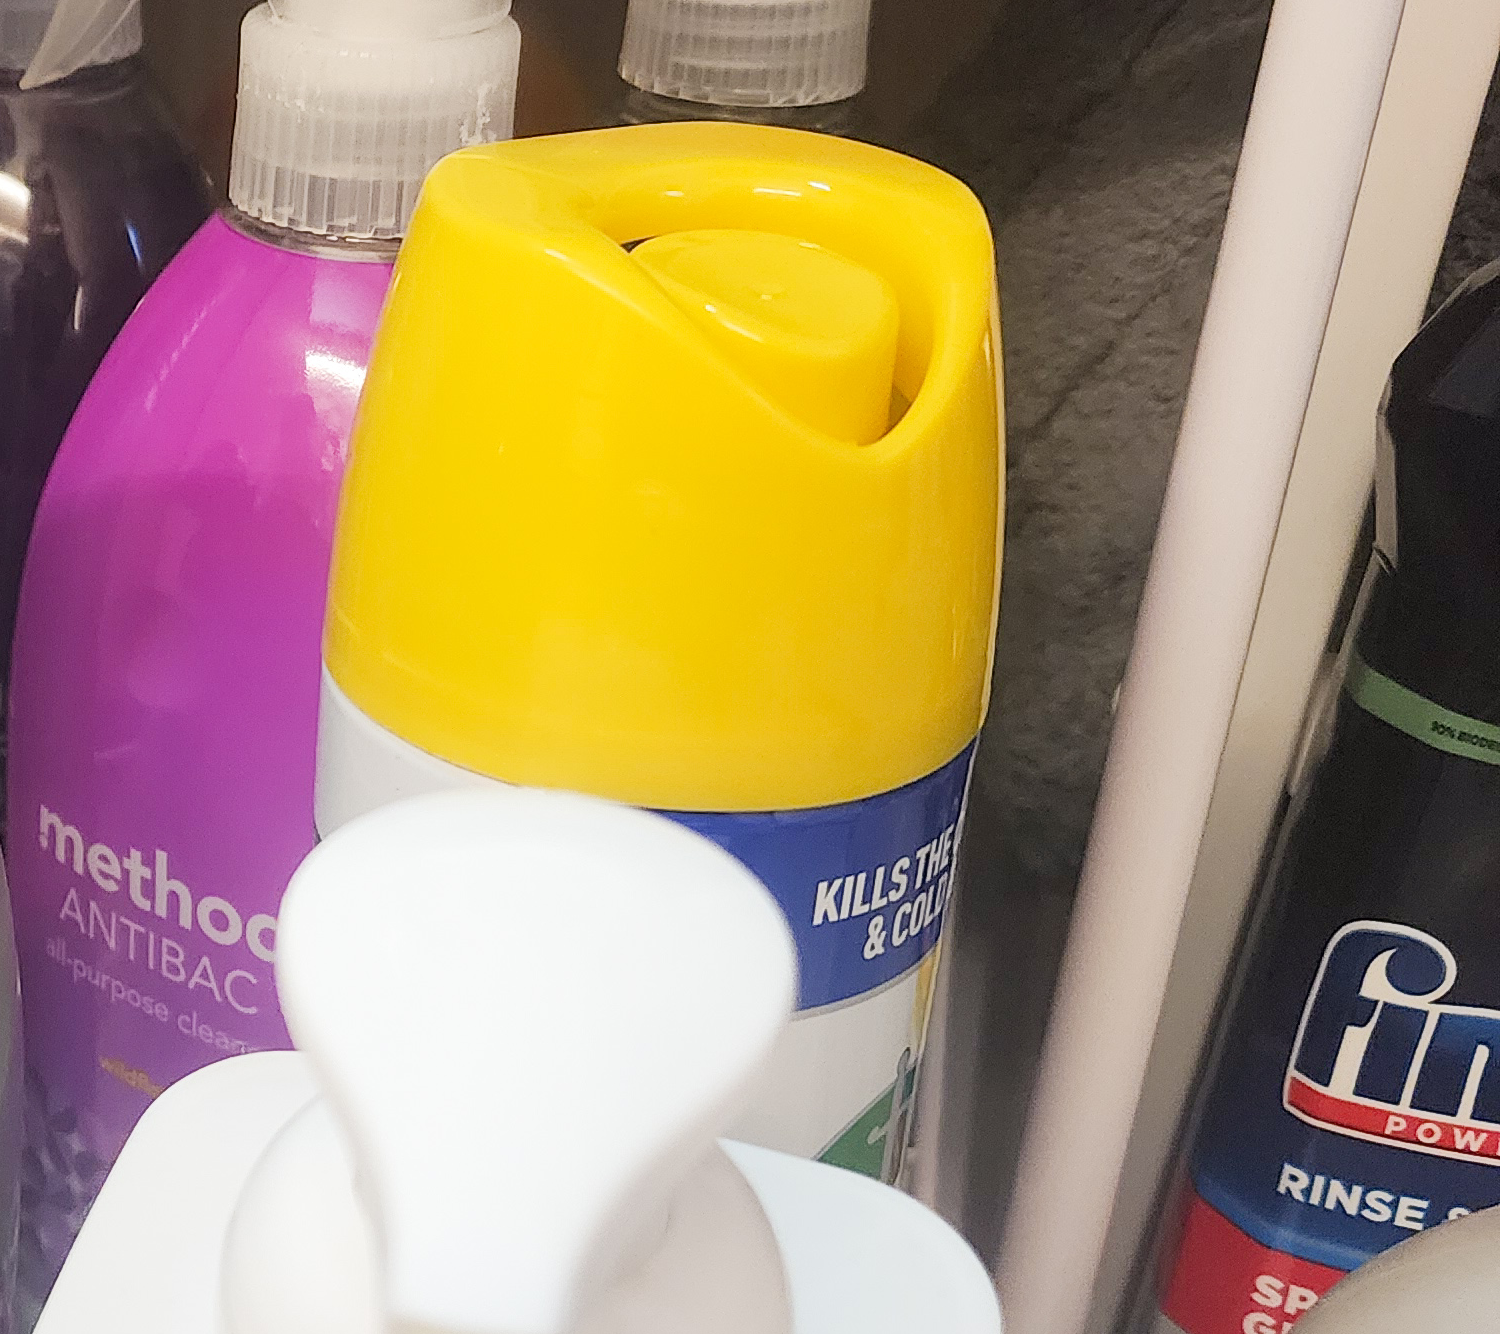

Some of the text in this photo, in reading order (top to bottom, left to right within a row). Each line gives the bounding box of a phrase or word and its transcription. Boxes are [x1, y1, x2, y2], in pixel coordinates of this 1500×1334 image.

[812, 823, 954, 926] KILLS THE
[863, 871, 948, 960] & COLD
[46, 936, 169, 1023] all-purpose
[59, 887, 258, 1015] ANTIBAC
[1384, 1113, 1500, 1155] POW
[1276, 1163, 1430, 1231] RINSE
